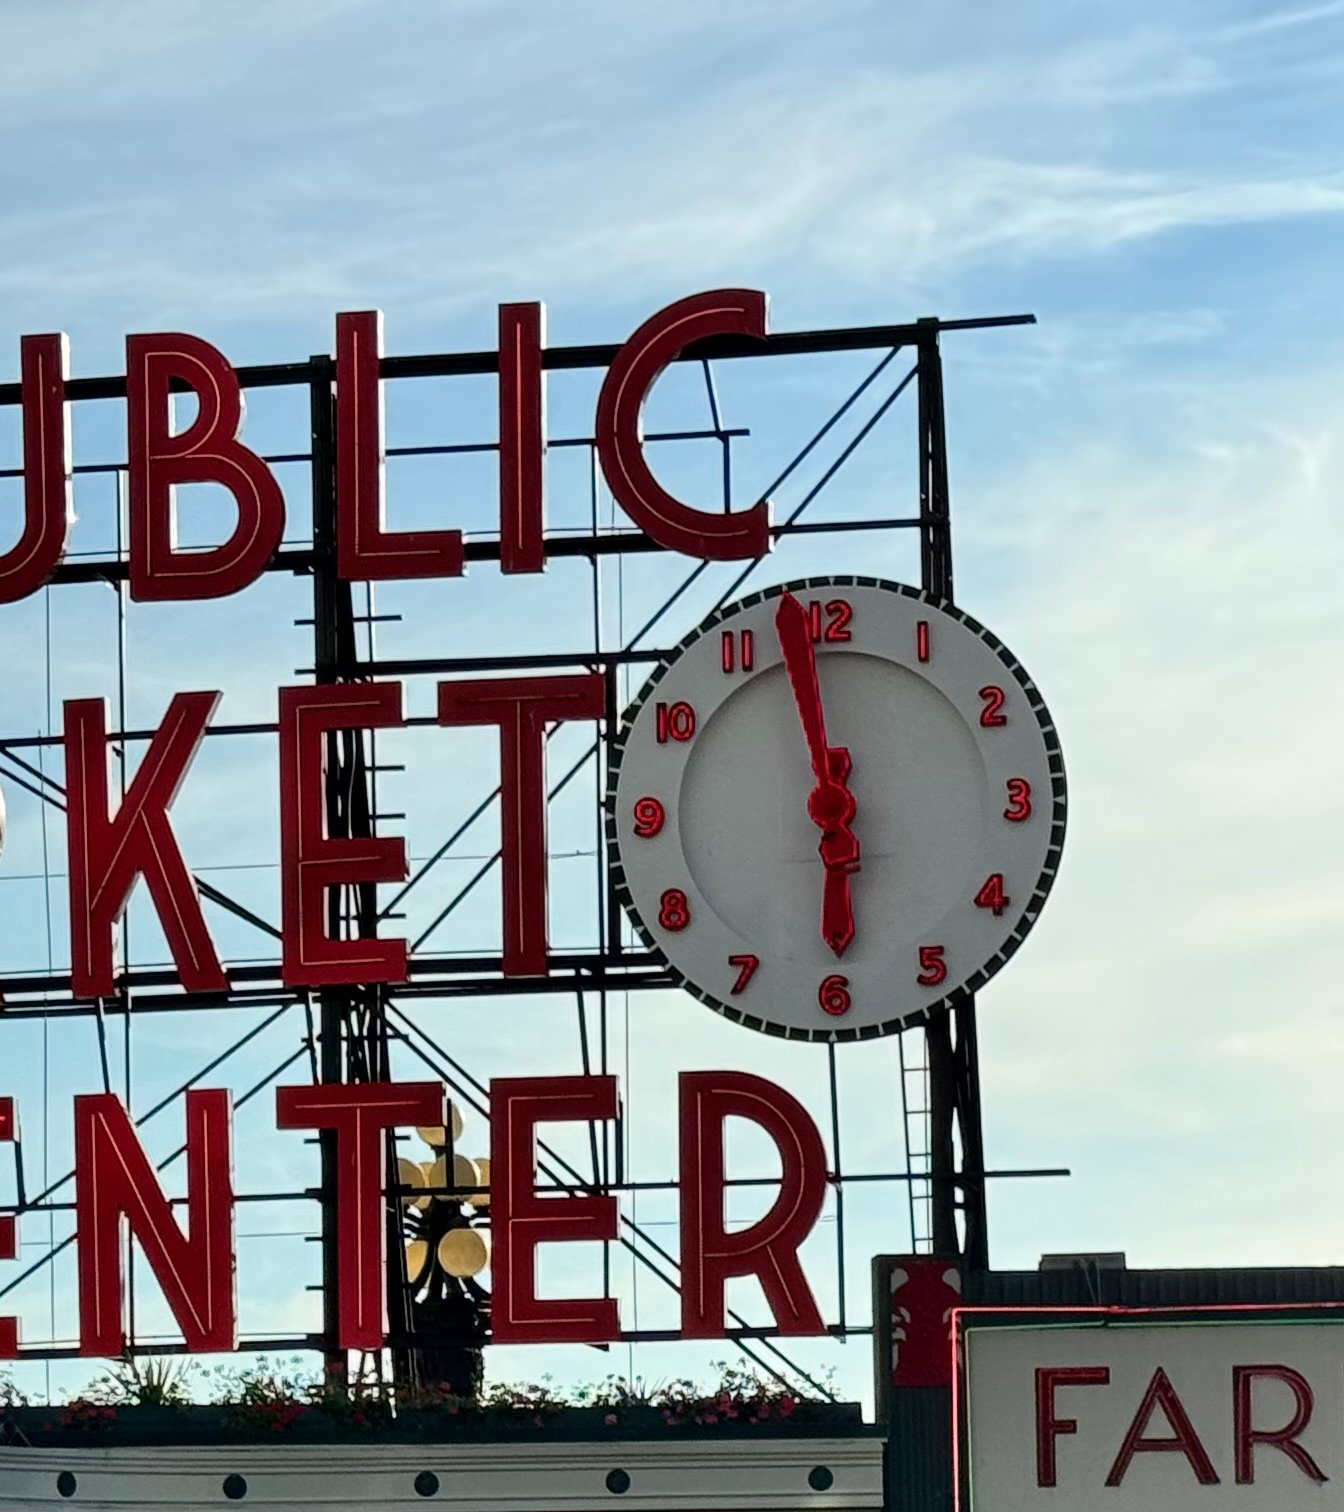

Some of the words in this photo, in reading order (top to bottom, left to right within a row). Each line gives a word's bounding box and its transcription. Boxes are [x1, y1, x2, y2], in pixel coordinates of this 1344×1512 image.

[809, 600, 853, 643] 12
[916, 621, 929, 663] 1
[722, 629, 754, 673] 11
[656, 702, 696, 743] 10
[979, 686, 1007, 727] 2
[633, 797, 665, 838] 9
[1004, 778, 1031, 822] 3
[658, 888, 691, 932] 8
[974, 873, 1010, 915] 4
[729, 954, 759, 994] 7
[917, 946, 947, 985] 5
[818, 974, 851, 1015] 6
